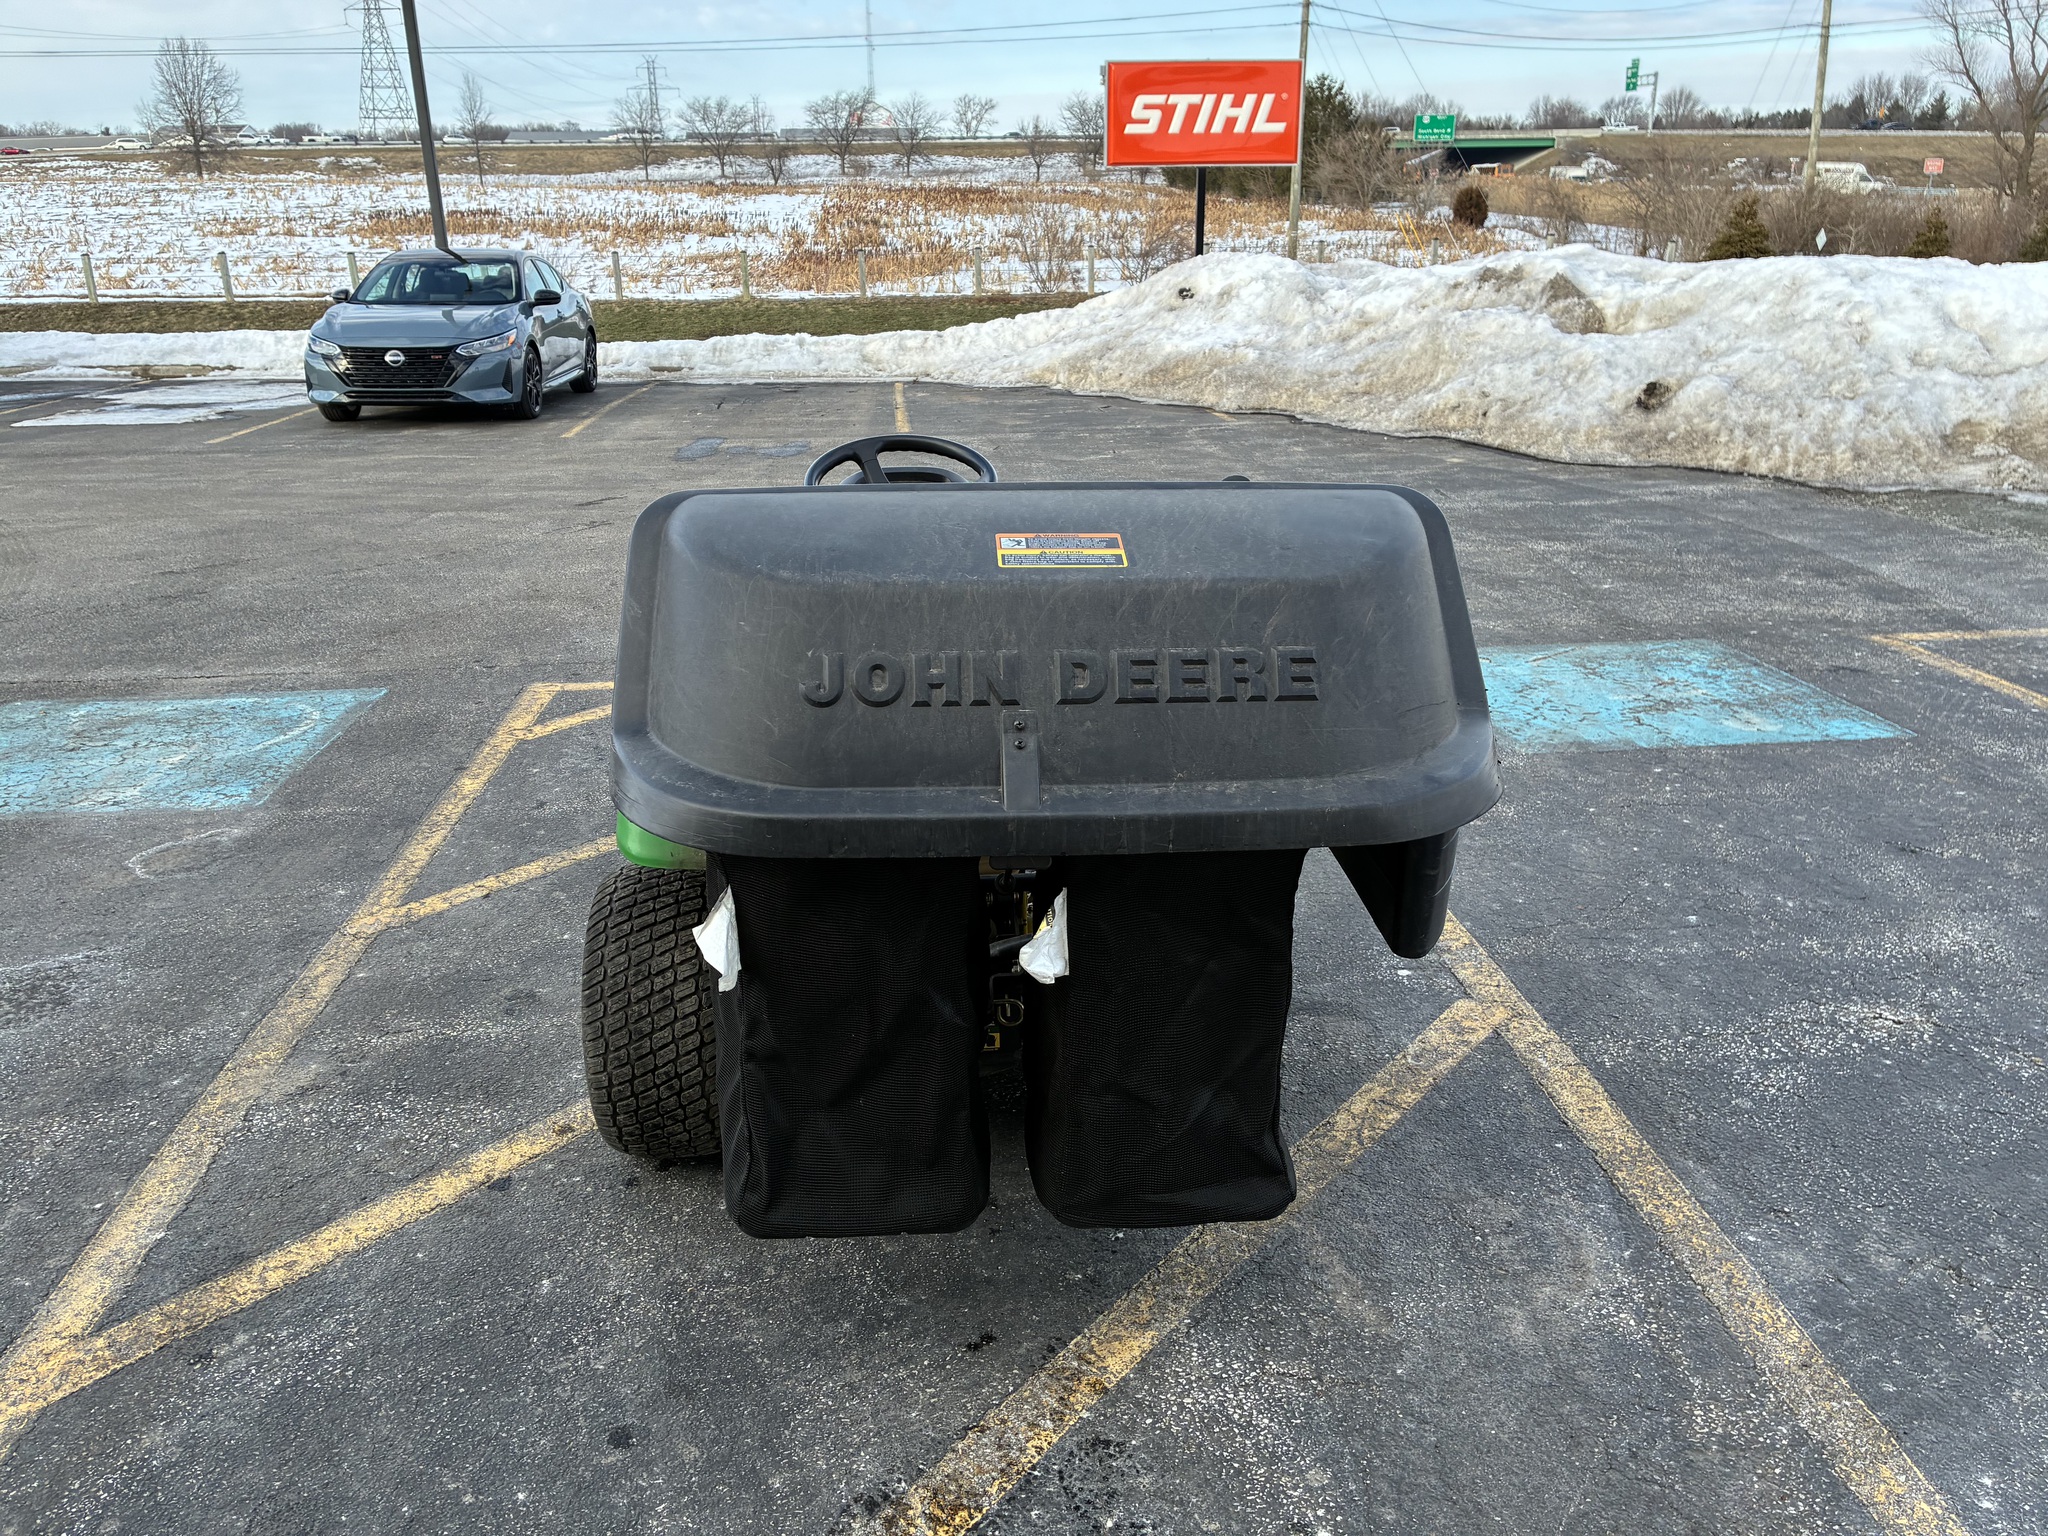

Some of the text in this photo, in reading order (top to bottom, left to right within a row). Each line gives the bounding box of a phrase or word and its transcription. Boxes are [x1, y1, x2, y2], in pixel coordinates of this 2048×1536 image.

[1123, 93, 1287, 135] STIHL
[800, 645, 1319, 708] JOHN DEERE
